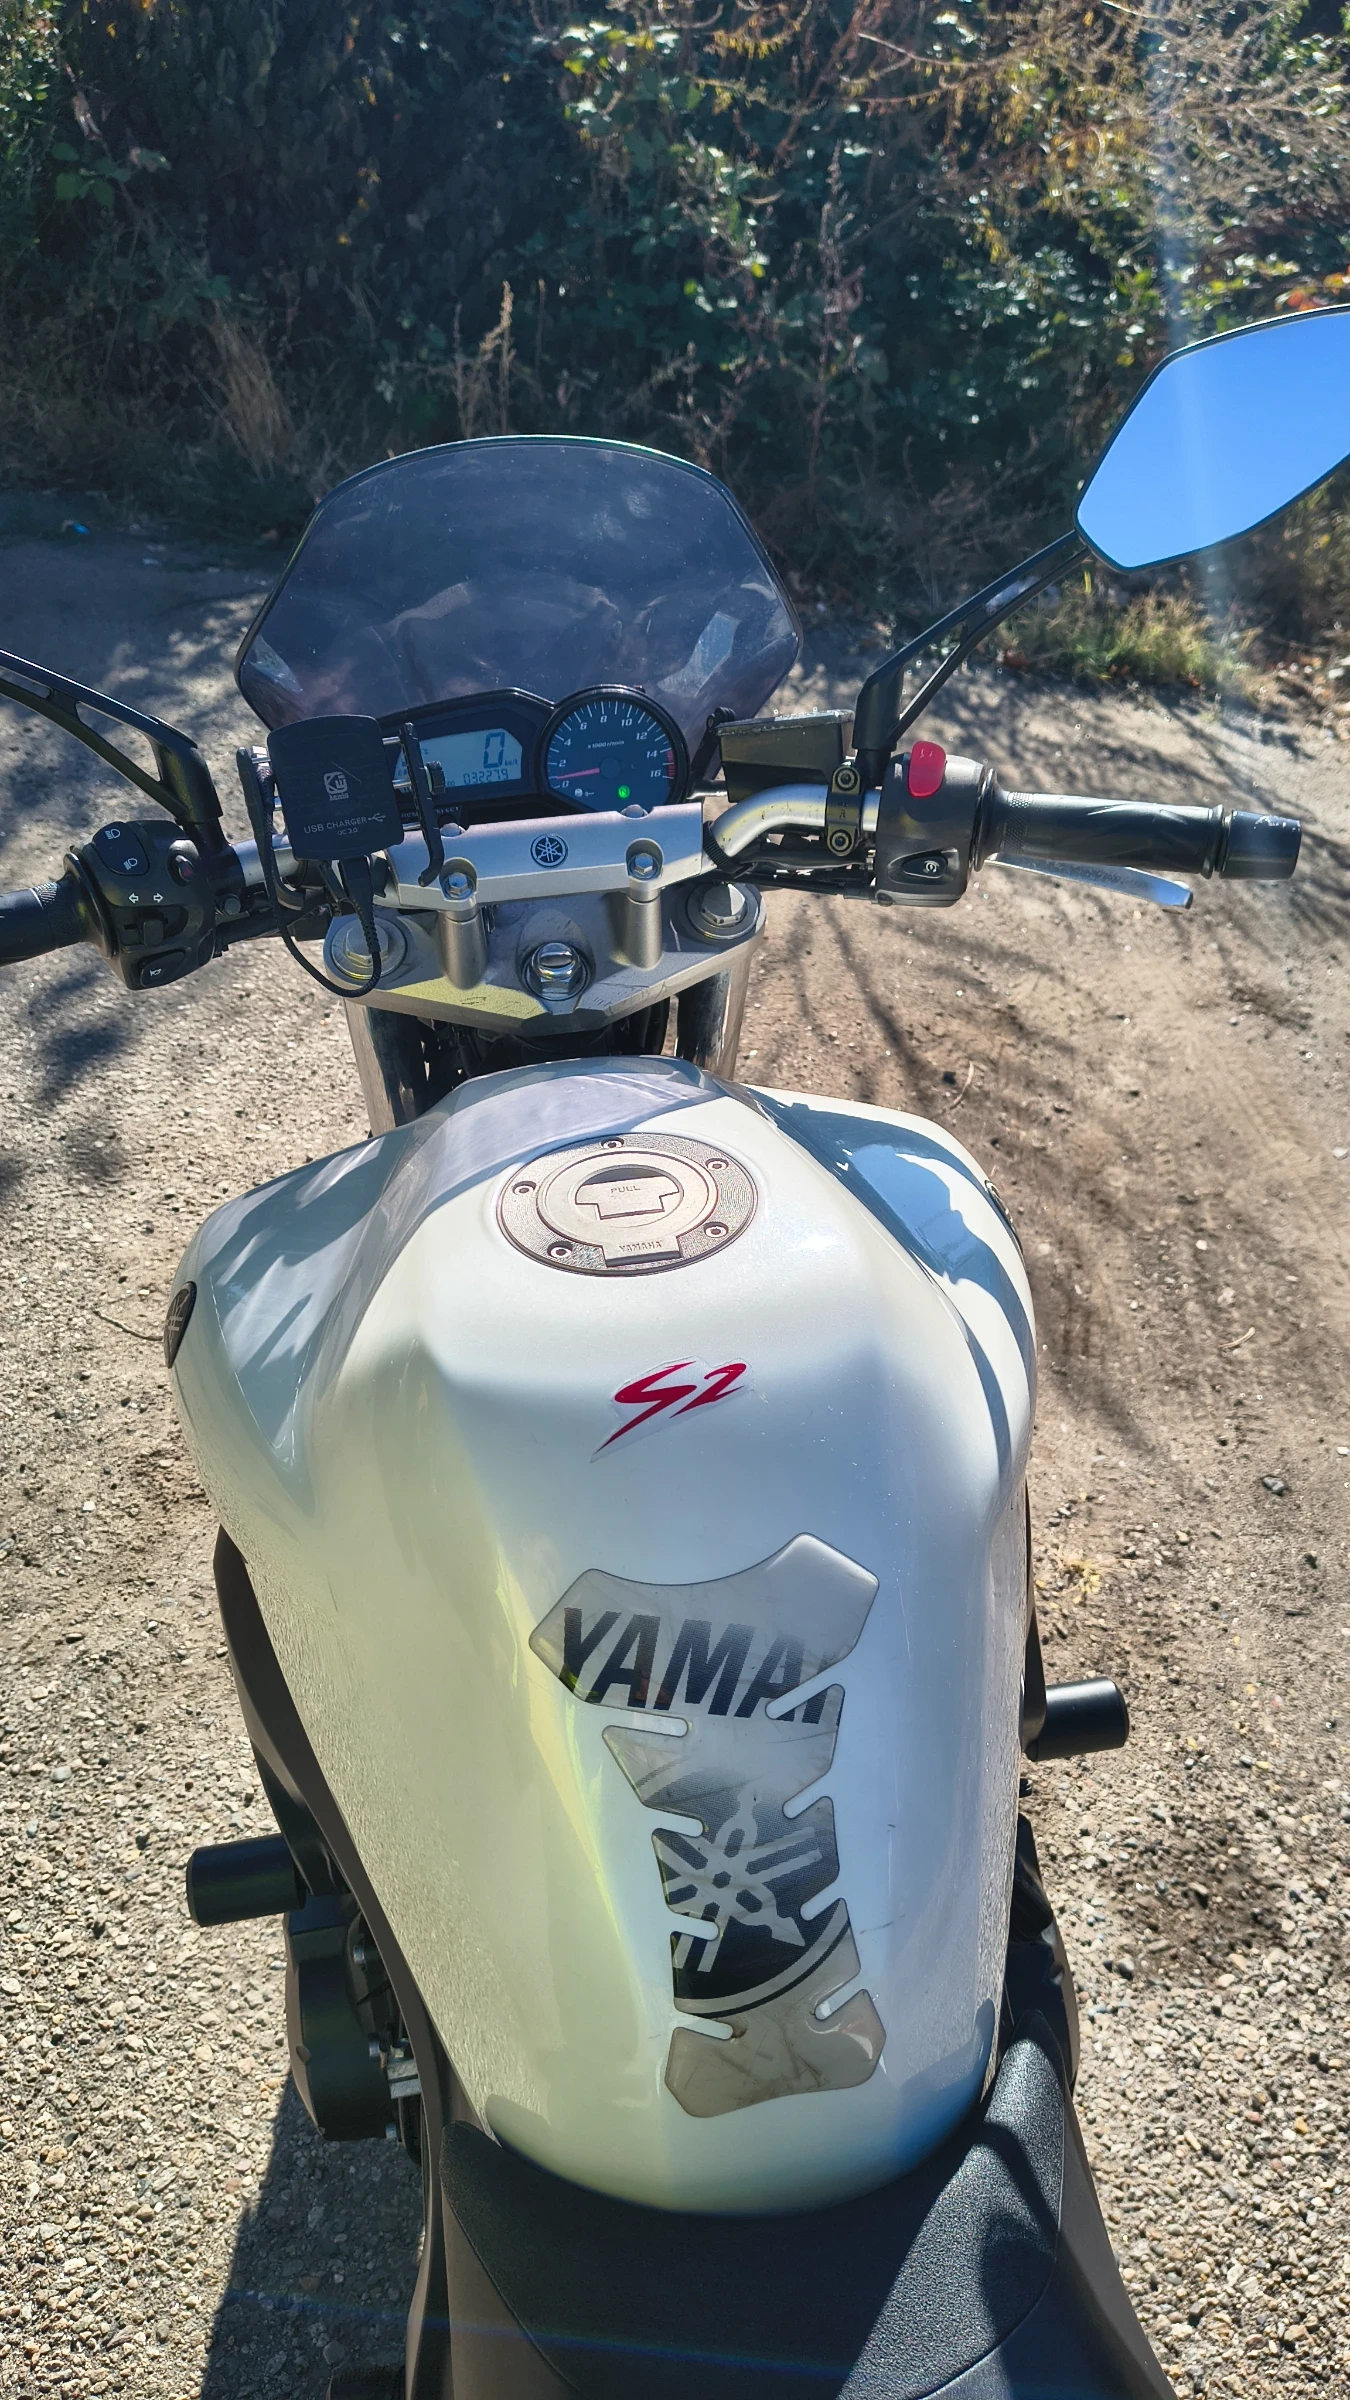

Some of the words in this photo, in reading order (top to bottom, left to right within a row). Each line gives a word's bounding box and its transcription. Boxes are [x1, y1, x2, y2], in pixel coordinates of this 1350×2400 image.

[600, 715, 608, 723] 8
[621, 718, 633, 727] 10
[579, 722, 588, 730] 6
[635, 731, 648, 741] 12
[563, 738, 572, 747] 4
[483, 731, 506, 769] 0
[646, 749, 658, 759] 14
[558, 759, 567, 768] 2
[462, 767, 509, 785] 032279
[650, 769, 662, 778] 16
[561, 780, 570, 788] 0
[303, 823, 325, 834] USB
[326, 816, 368, 830] CHARGER
[610, 1185, 641, 1194] PULL
[618, 1240, 662, 1252] YAMAHA
[593, 1359, 748, 1454] S2
